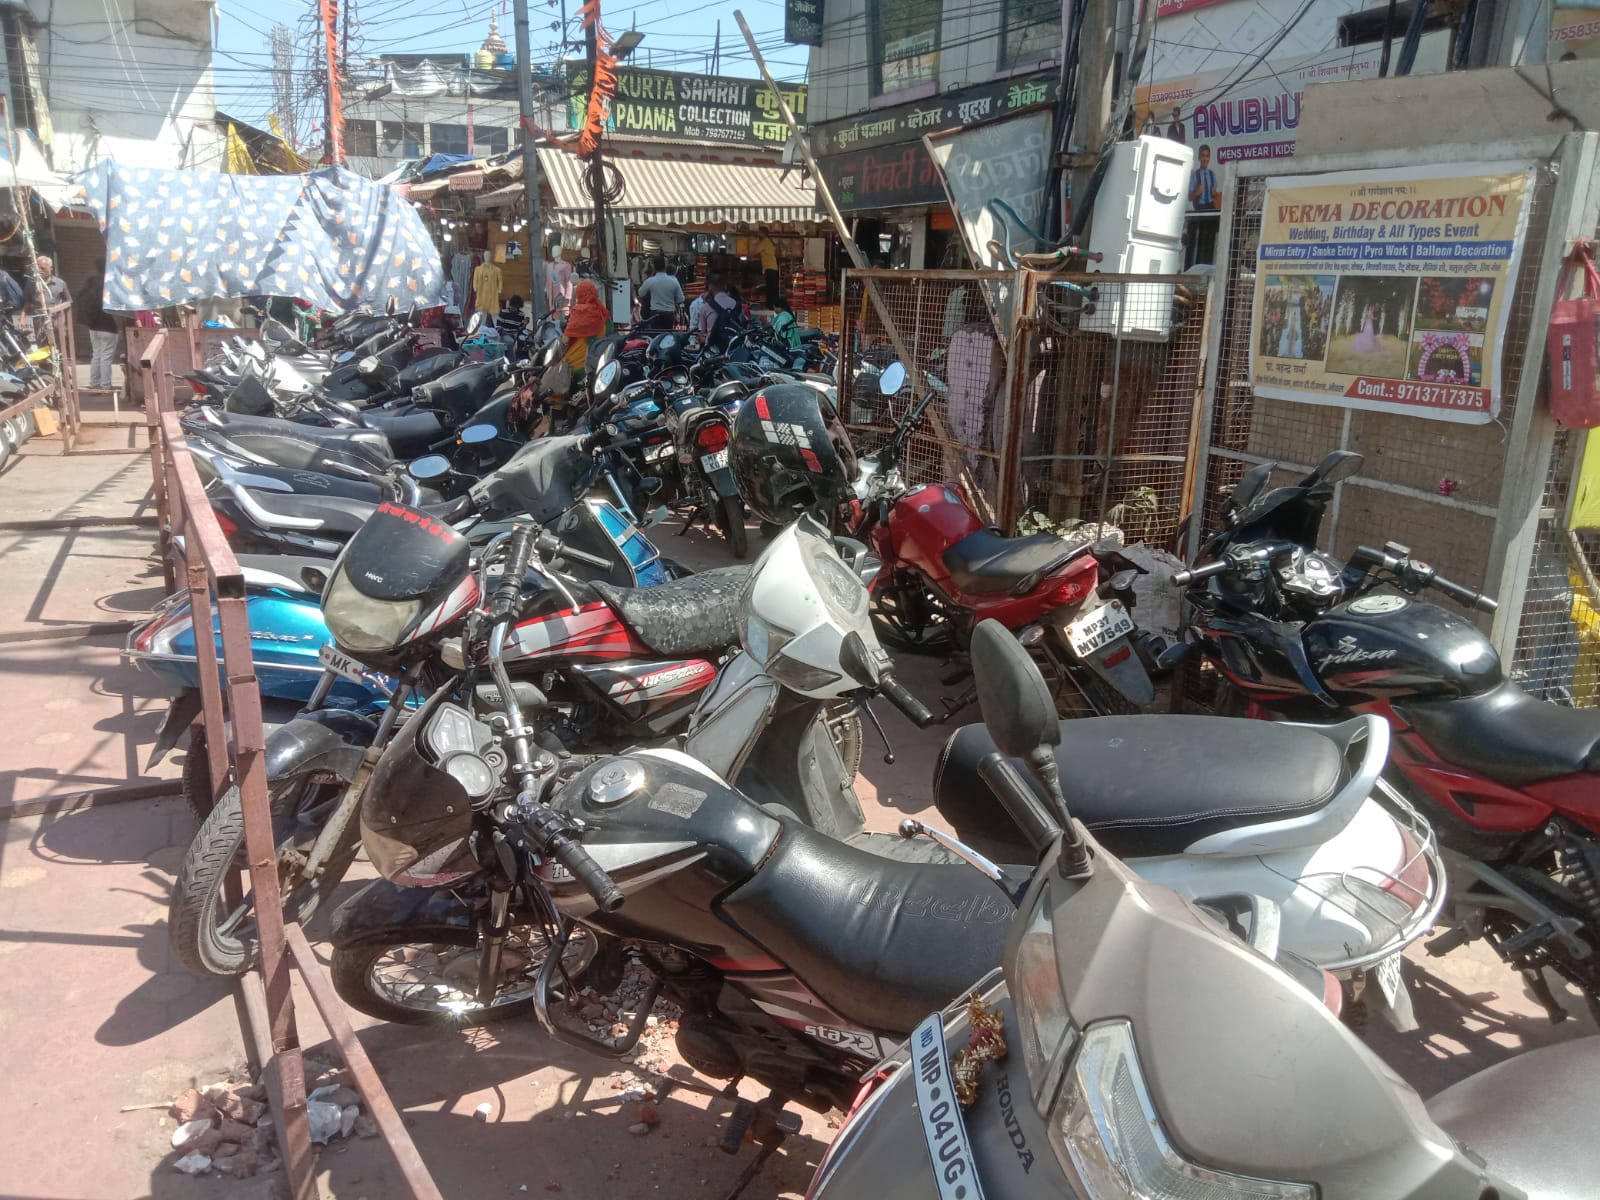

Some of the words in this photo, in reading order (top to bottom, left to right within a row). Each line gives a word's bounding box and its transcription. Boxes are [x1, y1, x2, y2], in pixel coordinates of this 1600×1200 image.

[618, 74, 676, 101] KURTA
[680, 77, 749, 106] SAMRAT
[616, 103, 676, 132] PAJAMA
[678, 105, 751, 127] COLLECTION
[860, 118, 896, 141] पजामा
[1007, 82, 1048, 108] जैकेट
[1219, 149, 1241, 160] MENS
[1243, 147, 1269, 158] WEAR
[1277, 203, 1342, 224] VERMA
[1348, 194, 1508, 222] DECORATION
[1289, 227, 1330, 243] Wedding,
[1333, 225, 1375, 241] Birthday
[1377, 225, 1386, 238] &
[1389, 225, 1404, 238] All
[1408, 224, 1441, 241] Types
[1445, 223, 1480, 237] Event
[1287, 246, 1306, 258] Entry
[1312, 246, 1335, 257] Smoke
[1337, 246, 1358, 258] Entry
[1364, 245, 1383, 258] Pyro
[1385, 245, 1408, 256] Work
[1416, 244, 1452, 256] Balloon
[1454, 243, 1507, 256] Decoration
[1397, 384, 1483, 407] 9713717375
[1077, 619, 1131, 655] MV7549
[1082, 615, 1110, 636] MP37
[329, 654, 352, 673] MK
[995, 1074, 1036, 1174] HONDA
